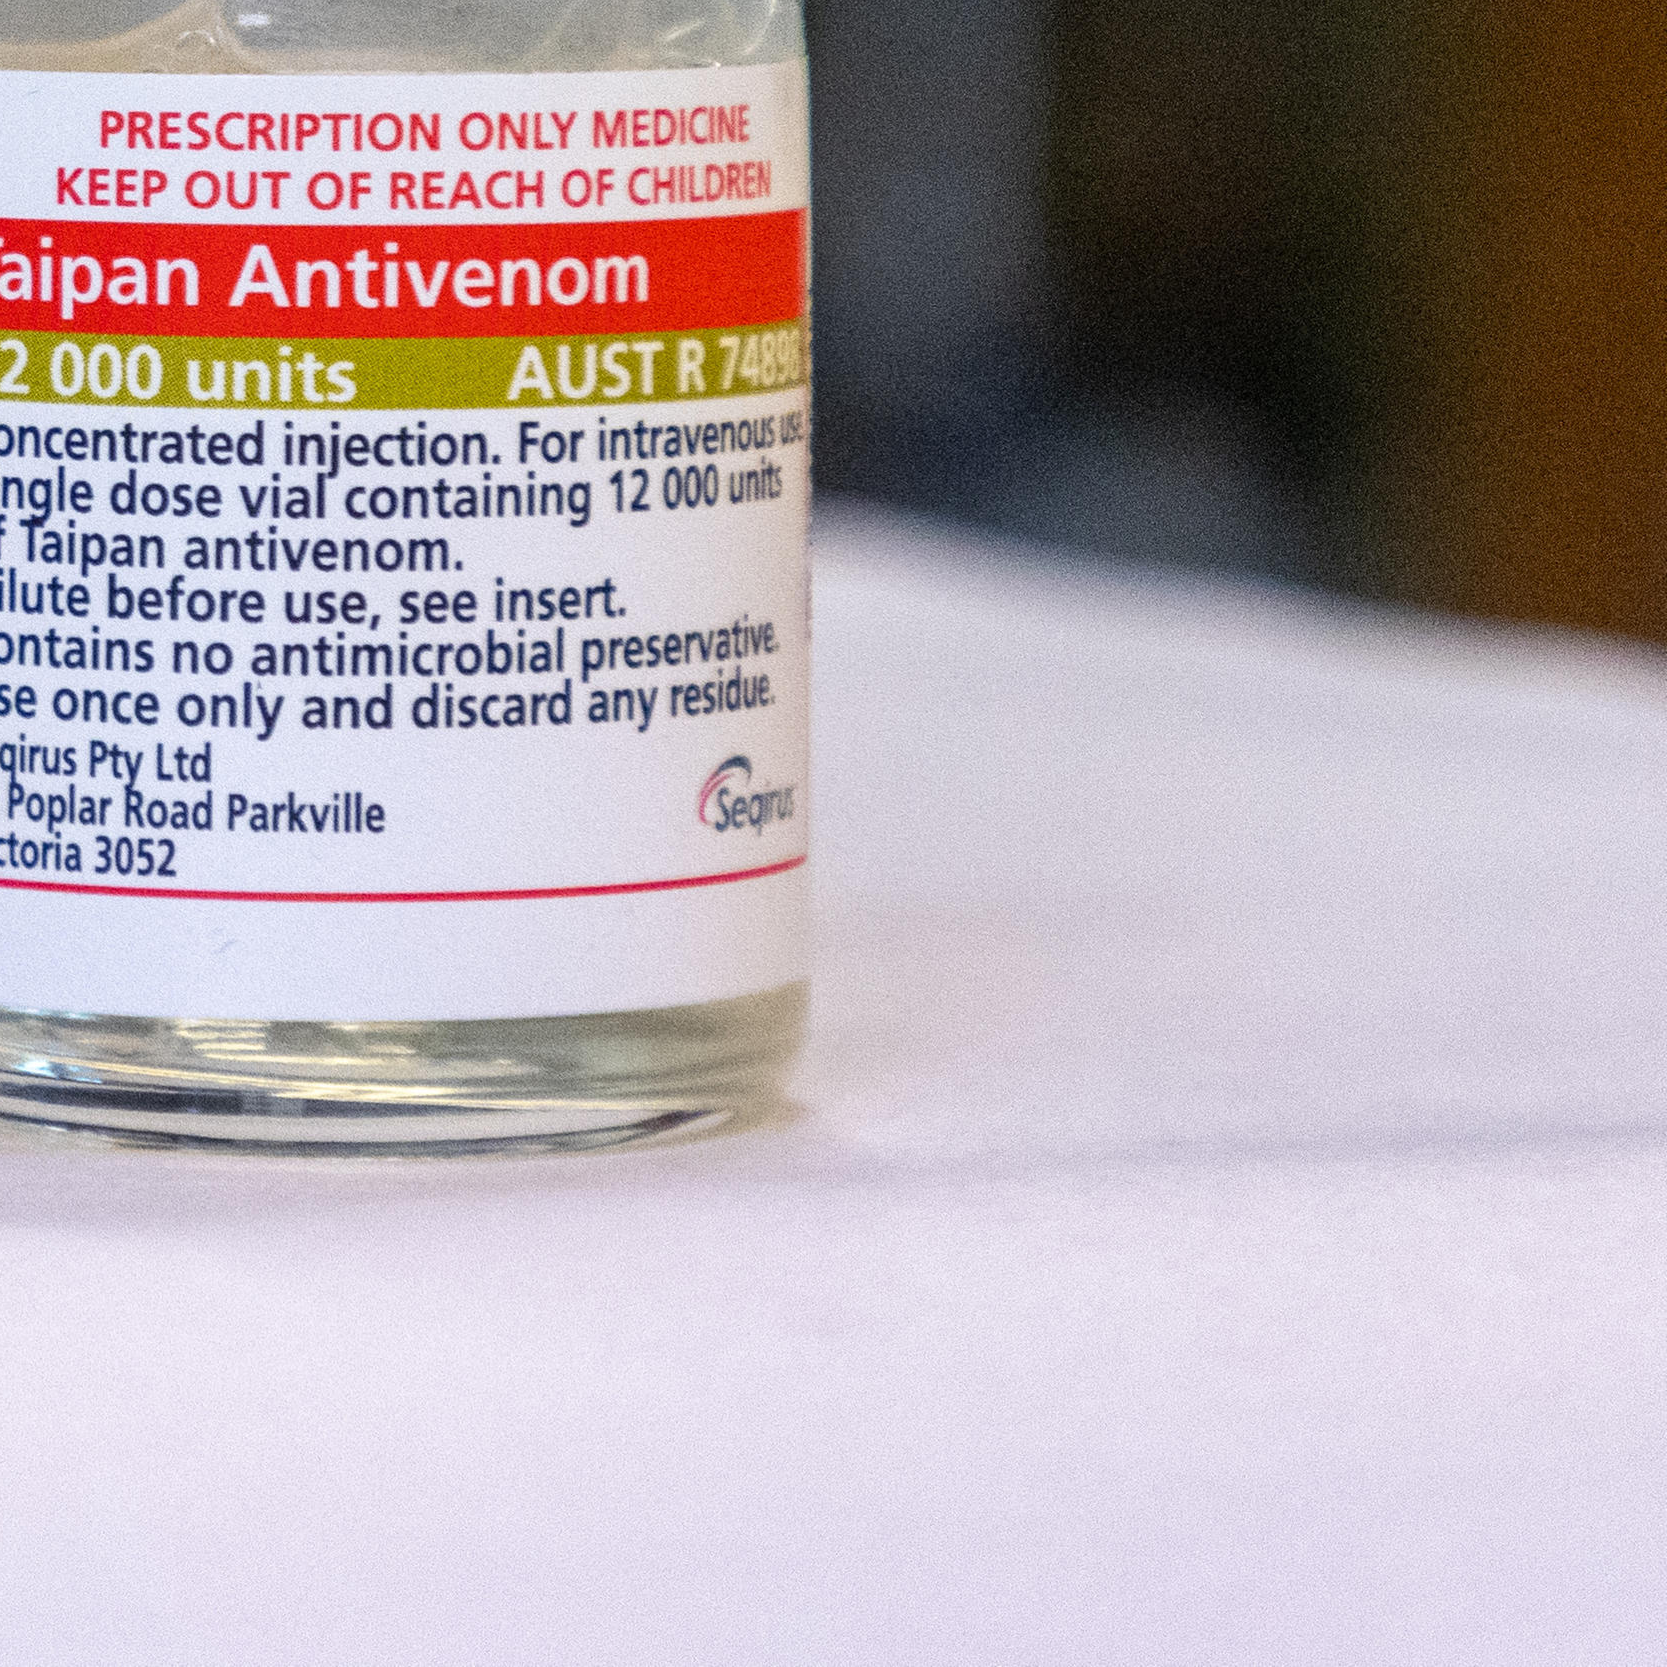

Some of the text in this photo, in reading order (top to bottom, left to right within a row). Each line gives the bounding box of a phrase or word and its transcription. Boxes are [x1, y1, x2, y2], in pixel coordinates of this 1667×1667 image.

[100, 104, 749, 152] PRESCRIPTION ONLY MEDICINE
[57, 161, 771, 211] KEEP OUT OF REACH OF CHILDREN
[228, 241, 649, 309] Antivenom
[50, 341, 163, 400] 000
[187, 345, 357, 403] units
[507, 340, 664, 401] AUST
[678, 338, 705, 393] R
[284, 421, 501, 478] injection.
[519, 421, 585, 464] For
[598, 416, 774, 461] intravenous
[109, 468, 222, 518] dose
[239, 472, 329, 520] vial
[344, 470, 591, 528] containing
[609, 468, 650, 512] 12
[662, 464, 719, 510] 000
[728, 458, 772, 505] units
[22, 520, 165, 576] Taipan
[183, 525, 463, 573] antivenom.
[107, 572, 266, 624] before
[284, 590, 381, 631] use,
[399, 590, 477, 624] see
[495, 577, 626, 622] insert.
[172, 640, 234, 675] no
[250, 626, 564, 677] antimicrobial
[581, 614, 779, 684] preservative.
[52, 687, 160, 726] once
[176, 681, 283, 742] only
[301, 682, 393, 730] and
[411, 678, 572, 729] discard
[587, 687, 658, 733] any
[670, 665, 775, 718] residue.
[89, 740, 144, 792] Pty
[156, 741, 212, 783] Ltd
[7, 780, 113, 834] Poplar
[123, 784, 213, 831] Road
[227, 791, 385, 834] Parkville
[94, 834, 177, 877] 3052
